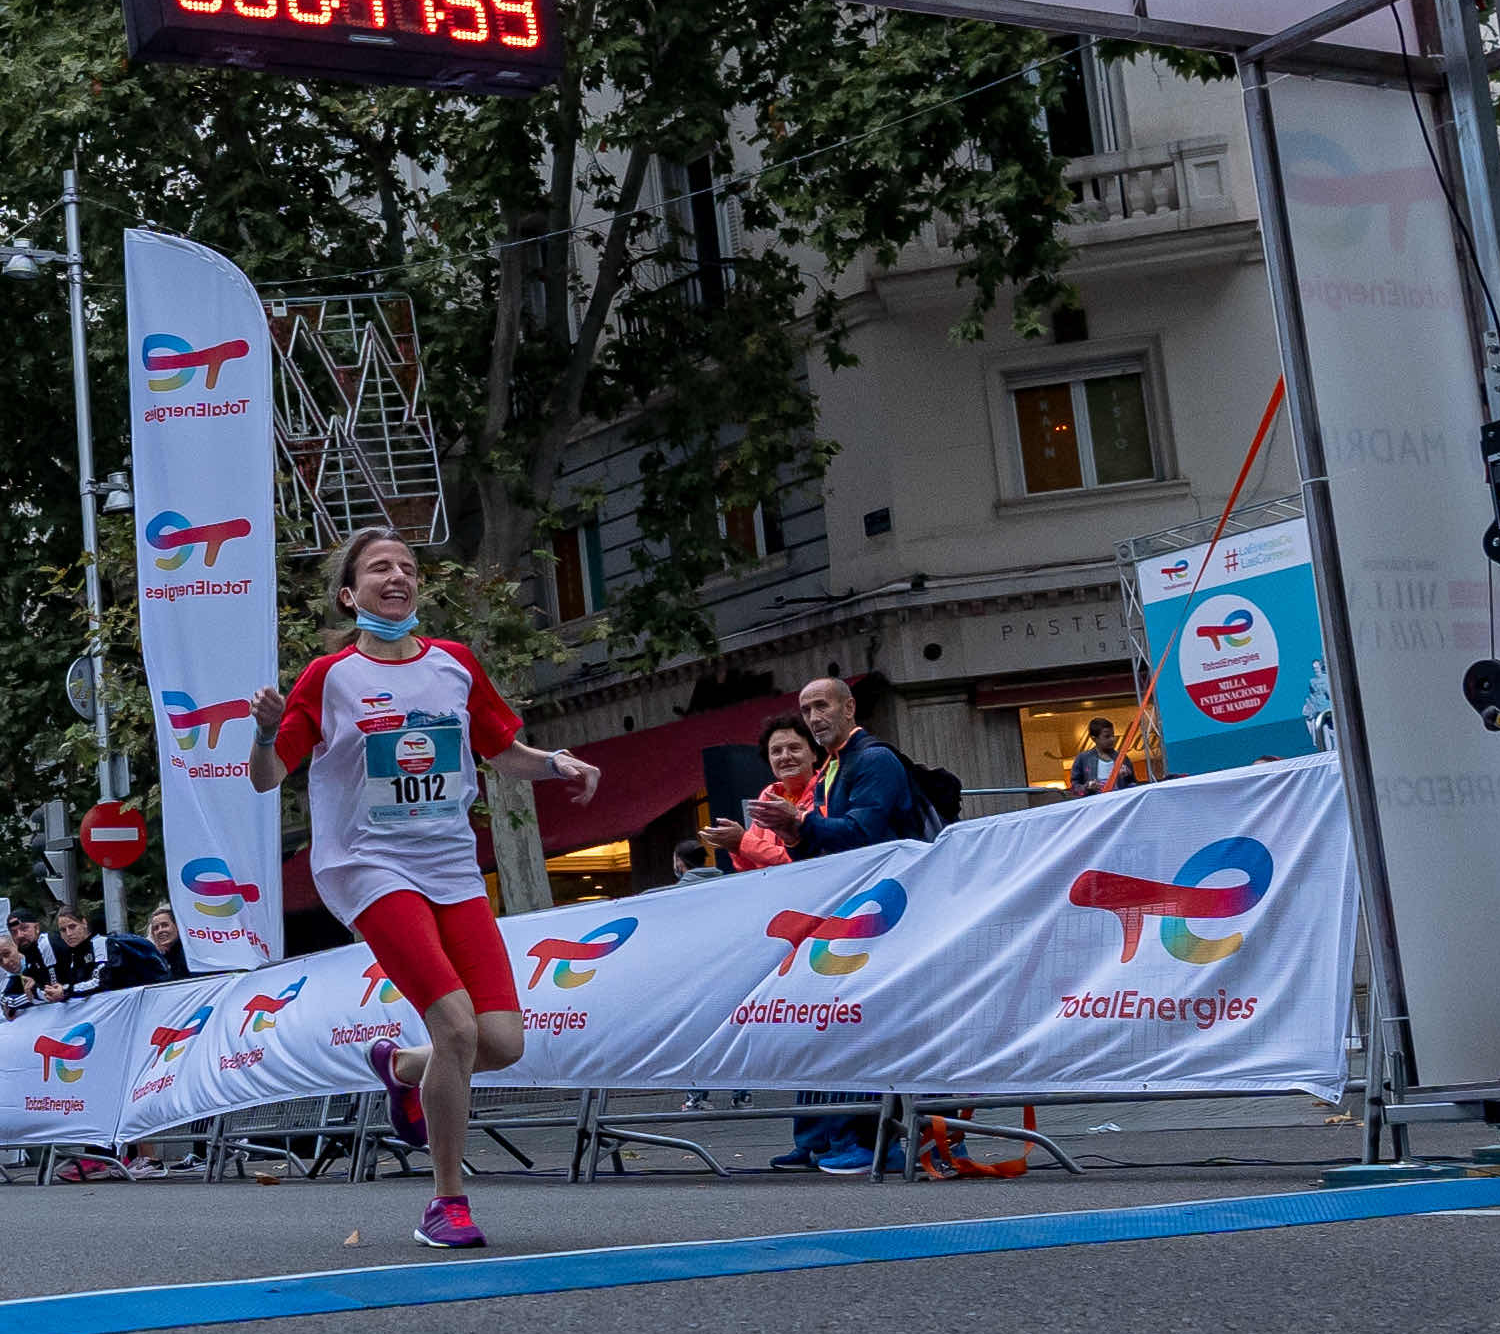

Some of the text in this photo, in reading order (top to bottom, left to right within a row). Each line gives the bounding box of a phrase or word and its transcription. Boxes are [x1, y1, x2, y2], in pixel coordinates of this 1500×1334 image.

[1200, 651, 1261, 672] TotalEnergies
[1218, 677, 1248, 691] MILLA
[1212, 698, 1261, 715] DE MADRID
[390, 774, 447, 804] 1012
[1055, 988, 1258, 1030] TotalEnergies
